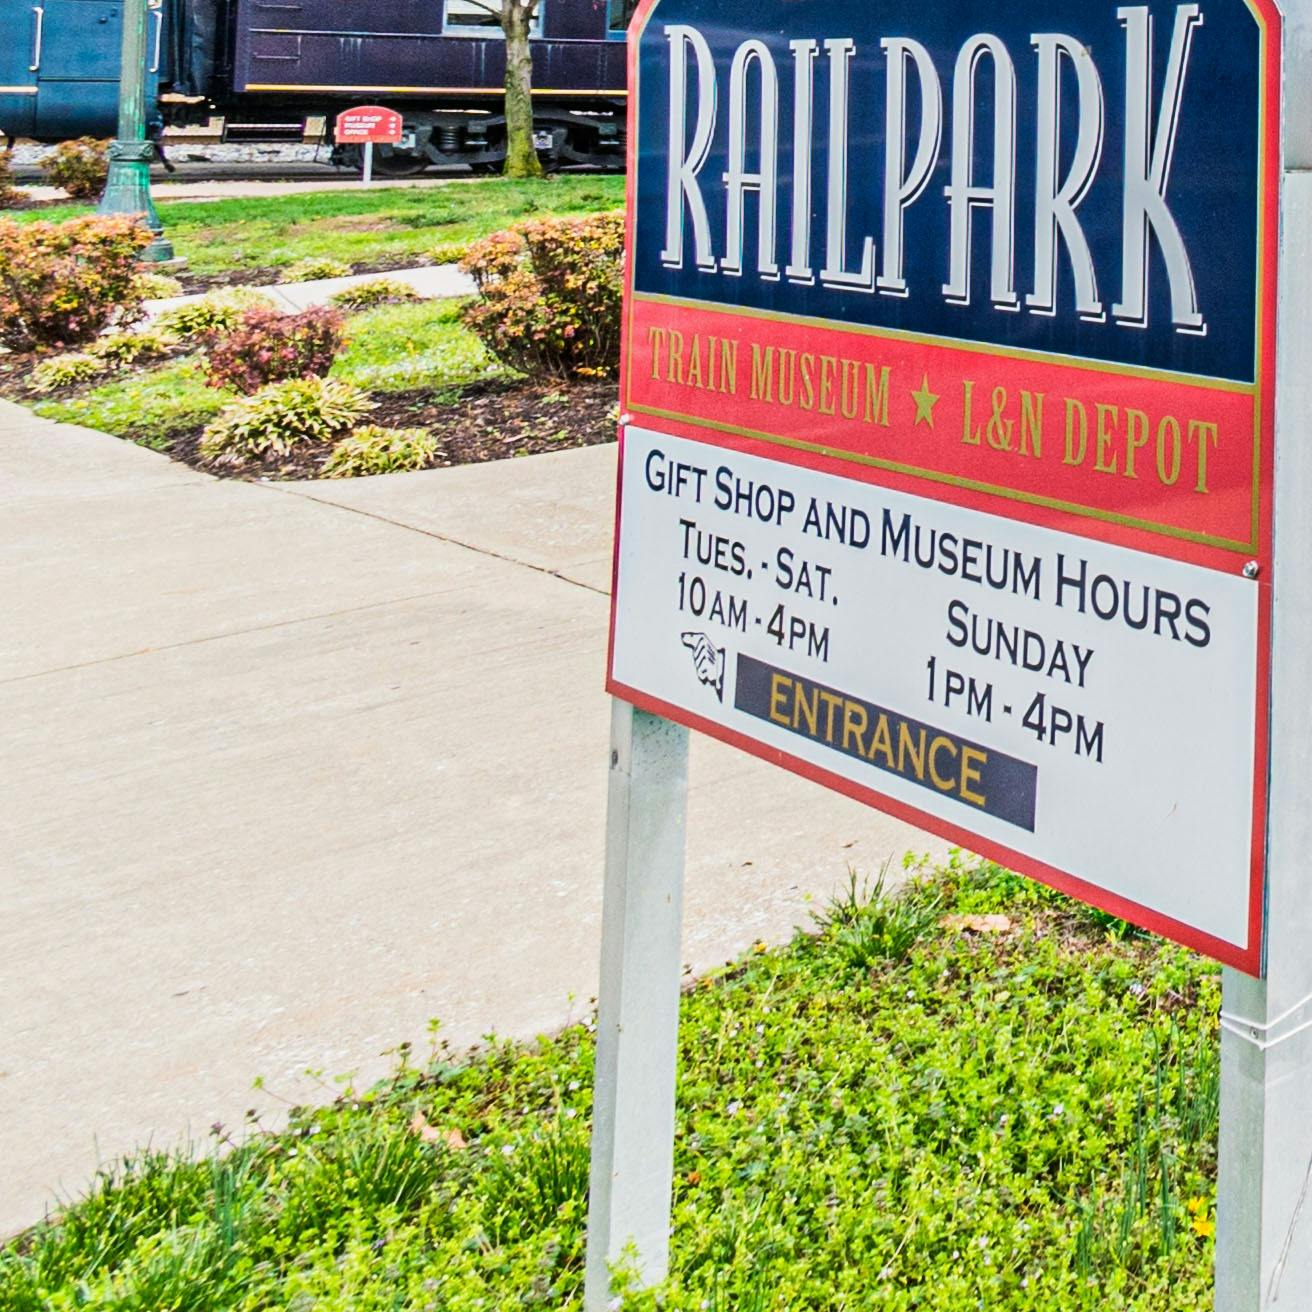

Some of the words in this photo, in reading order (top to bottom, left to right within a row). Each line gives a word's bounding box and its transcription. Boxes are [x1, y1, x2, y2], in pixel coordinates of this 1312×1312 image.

[661, 3, 1208, 337] RAILPARK
[648, 323, 740, 395] TRAIN
[750, 342, 892, 427] MUSEUM
[961, 379, 1045, 458] L&N
[1062, 397, 1219, 494] DEPOT
[645, 449, 708, 504] GIFT
[714, 466, 795, 526] SHOP
[802, 497, 870, 549] AND
[880, 508, 1042, 600] MUSEUM
[1055, 553, 1211, 648] HOURS
[679, 518, 753, 581] TUES.
[775, 547, 839, 607] SAT.
[766, 603, 830, 663] 4PM
[946, 599, 1095, 689] SUNDAY
[769, 673, 989, 807] ENTRANCE
[1022, 692, 1105, 764] 4PM
